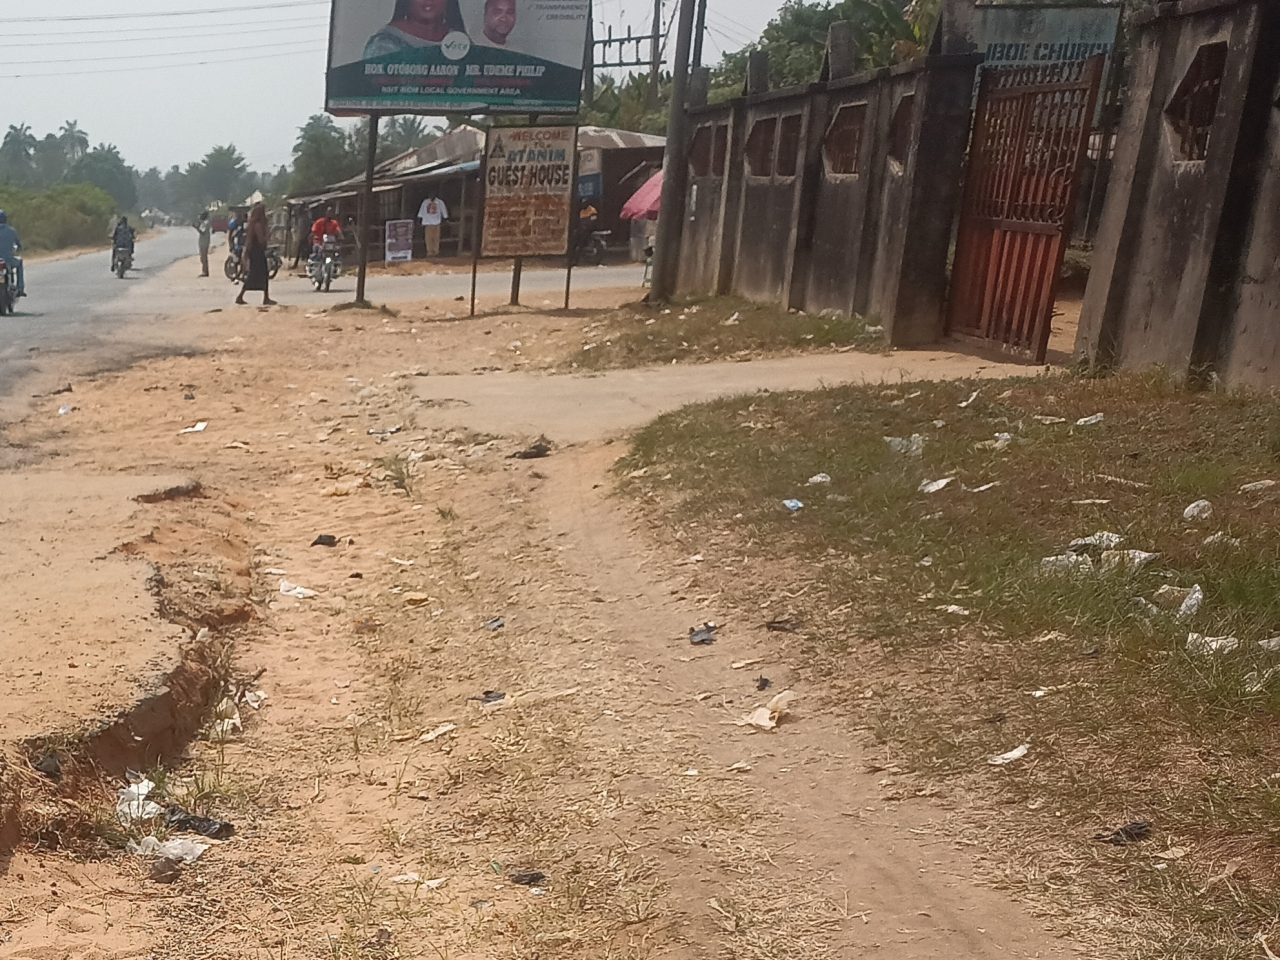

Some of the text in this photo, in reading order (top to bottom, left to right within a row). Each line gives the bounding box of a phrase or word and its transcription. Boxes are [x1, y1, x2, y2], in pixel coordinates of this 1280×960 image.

[429, 65, 460, 76] AARON
[516, 65, 546, 77] PHILIP
[420, 86, 444, 94] LOCAL
[446, 86, 498, 95] GOVERNMENT
[499, 87, 521, 96] AREA
[511, 130, 570, 140] WELCOME
[488, 164, 570, 186] GUEST HOUSE
